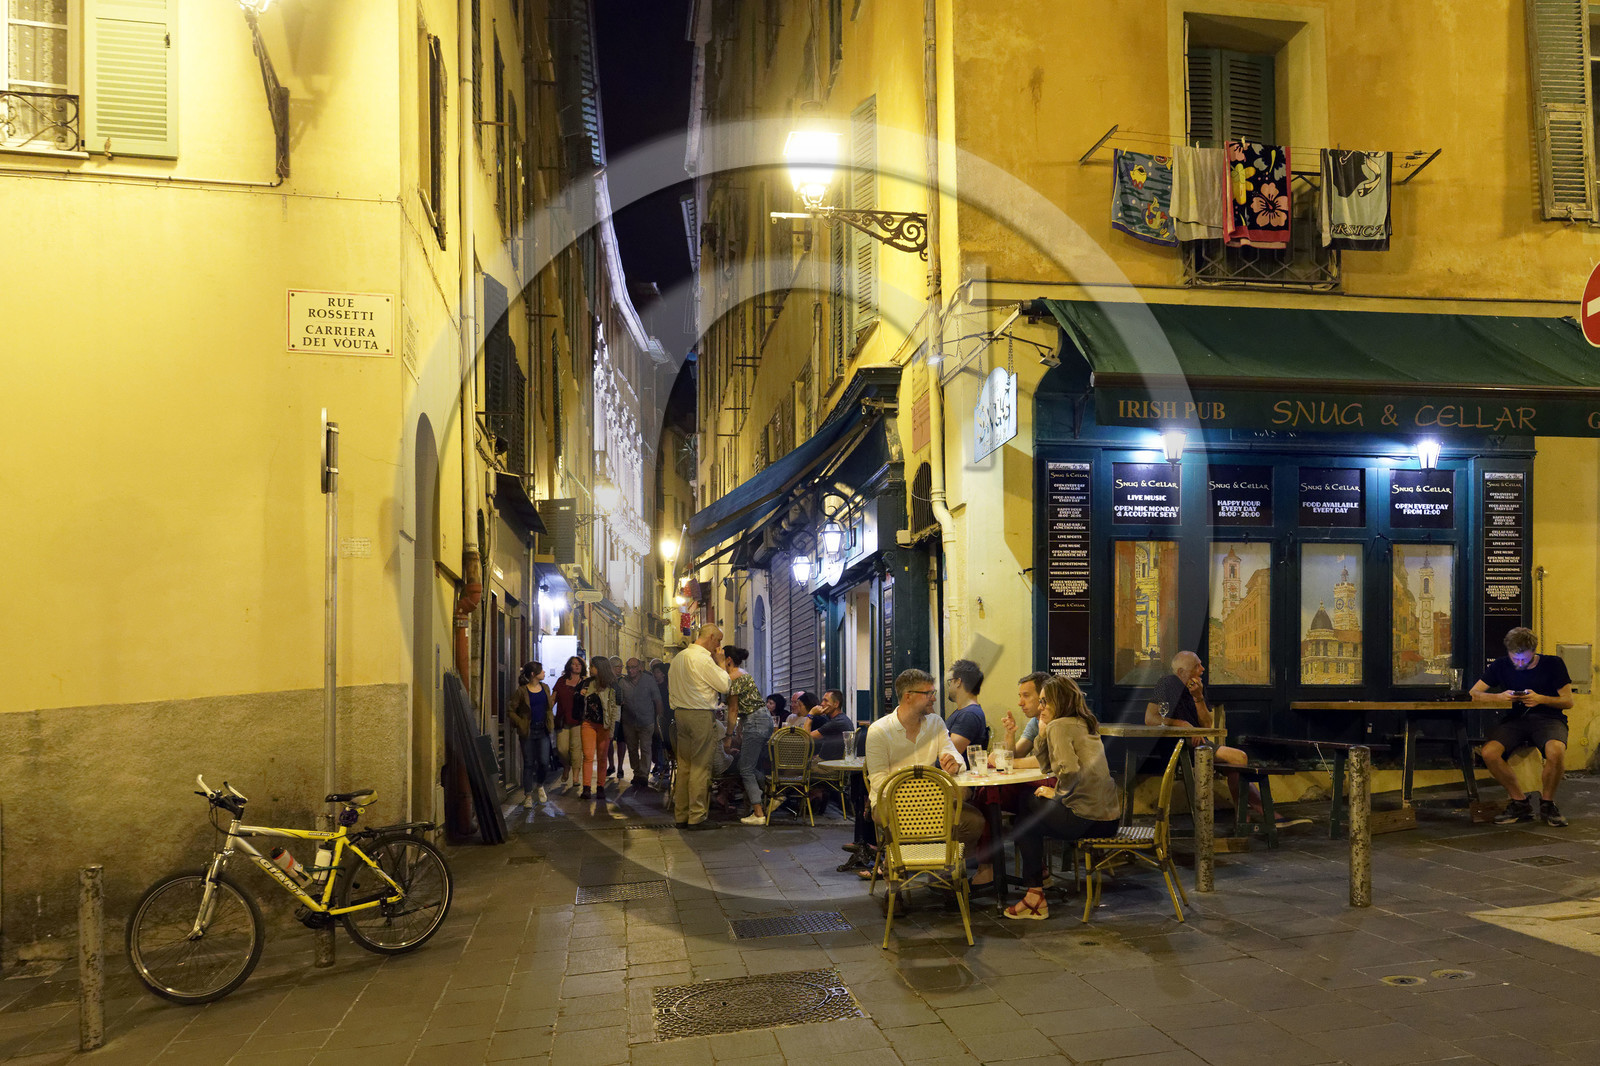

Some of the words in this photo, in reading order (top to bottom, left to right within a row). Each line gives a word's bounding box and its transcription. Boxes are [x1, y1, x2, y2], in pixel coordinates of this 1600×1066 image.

[328, 298, 354, 308] RUE
[308, 308, 374, 320] ROSSETTI
[305, 324, 376, 337] CARRIERA
[302, 336, 326, 347] DEI
[1118, 400, 1177, 418] IRISH
[1184, 402, 1226, 420] PUB
[1271, 400, 1364, 427] SNUG
[1380, 404, 1399, 426] &
[1414, 405, 1537, 431] CELLAR
[1114, 479, 1138, 490] Snug
[1148, 480, 1178, 489] Cellar
[1208, 481, 1230, 490] Snug
[1240, 482, 1270, 490] Cellar
[1300, 482, 1322, 492] Snug
[1332, 484, 1360, 492] Cellar
[1392, 484, 1414, 494] Snug
[1422, 484, 1452, 494] Cellar
[258, 858, 306, 896] GIANT
